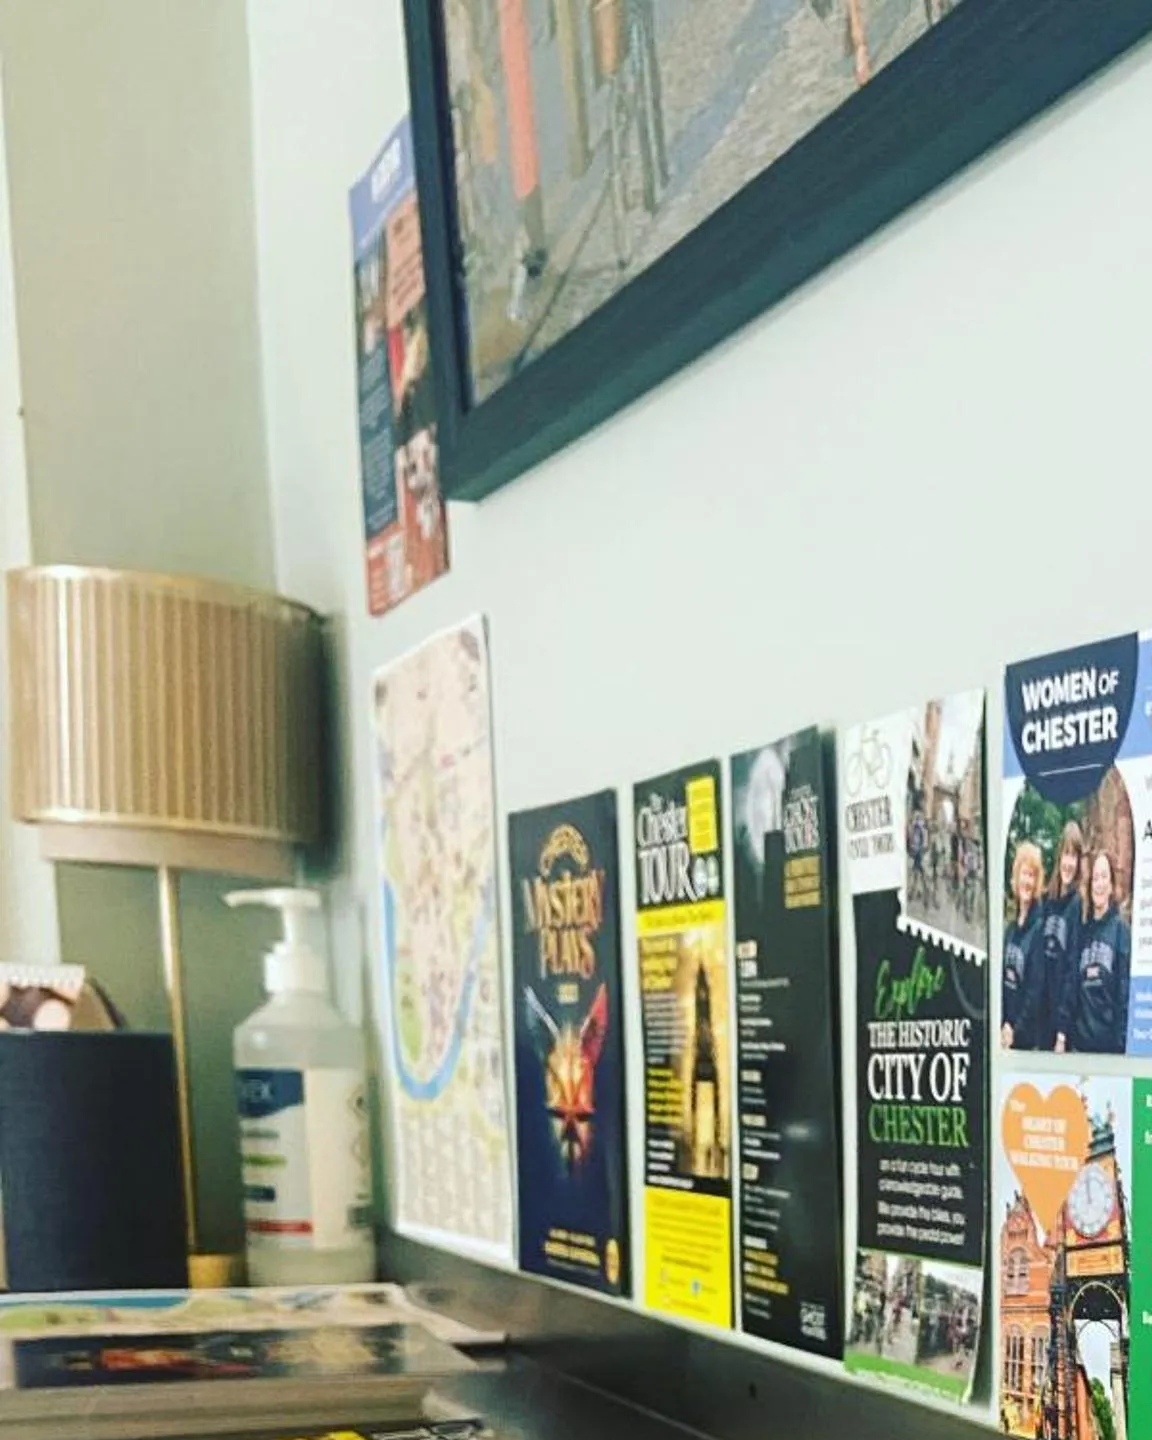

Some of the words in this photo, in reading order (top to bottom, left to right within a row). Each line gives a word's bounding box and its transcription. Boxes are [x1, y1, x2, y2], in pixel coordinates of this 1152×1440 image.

[1022, 667, 1097, 713] WOMEN
[1098, 669, 1120, 697] OF
[1021, 707, 1119, 756] CHESTER
[867, 1021, 896, 1048] THE
[897, 1018, 972, 1048] HISTORIC
[867, 1053, 926, 1101] CITY
[928, 1052, 971, 1102] OF
[867, 1105, 969, 1148] CHESTER
